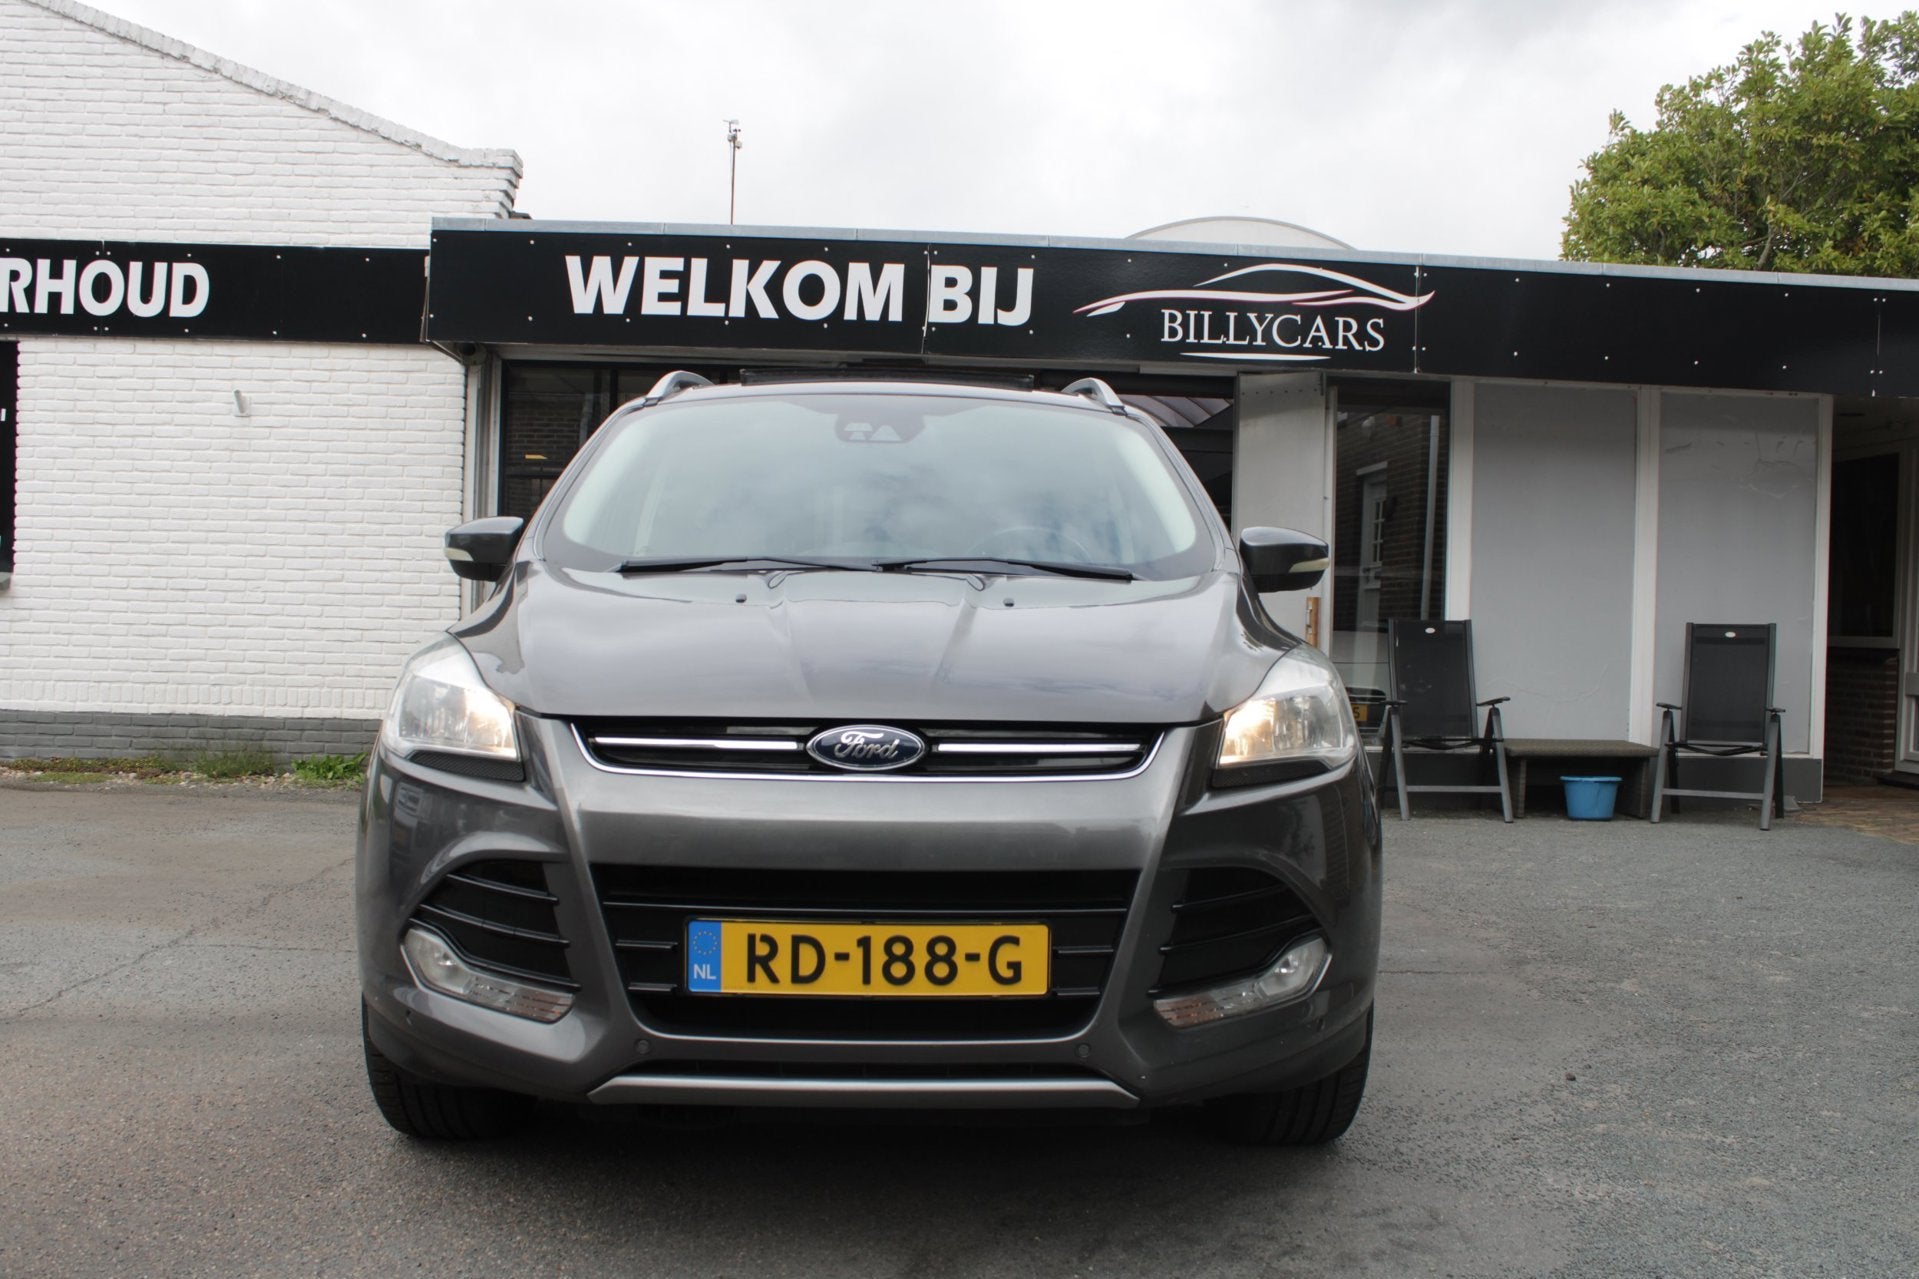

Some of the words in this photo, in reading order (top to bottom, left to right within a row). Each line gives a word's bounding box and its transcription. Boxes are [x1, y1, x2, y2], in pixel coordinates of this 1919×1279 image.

[0, 257, 210, 318] RHOUD
[565, 255, 905, 322] WELKOM
[928, 264, 1034, 327] BIJ
[1160, 309, 1385, 352] BILLYCARS
[834, 731, 900, 759] Ford
[693, 964, 717, 980] NL
[746, 933, 1022, 987] RD-188-G
